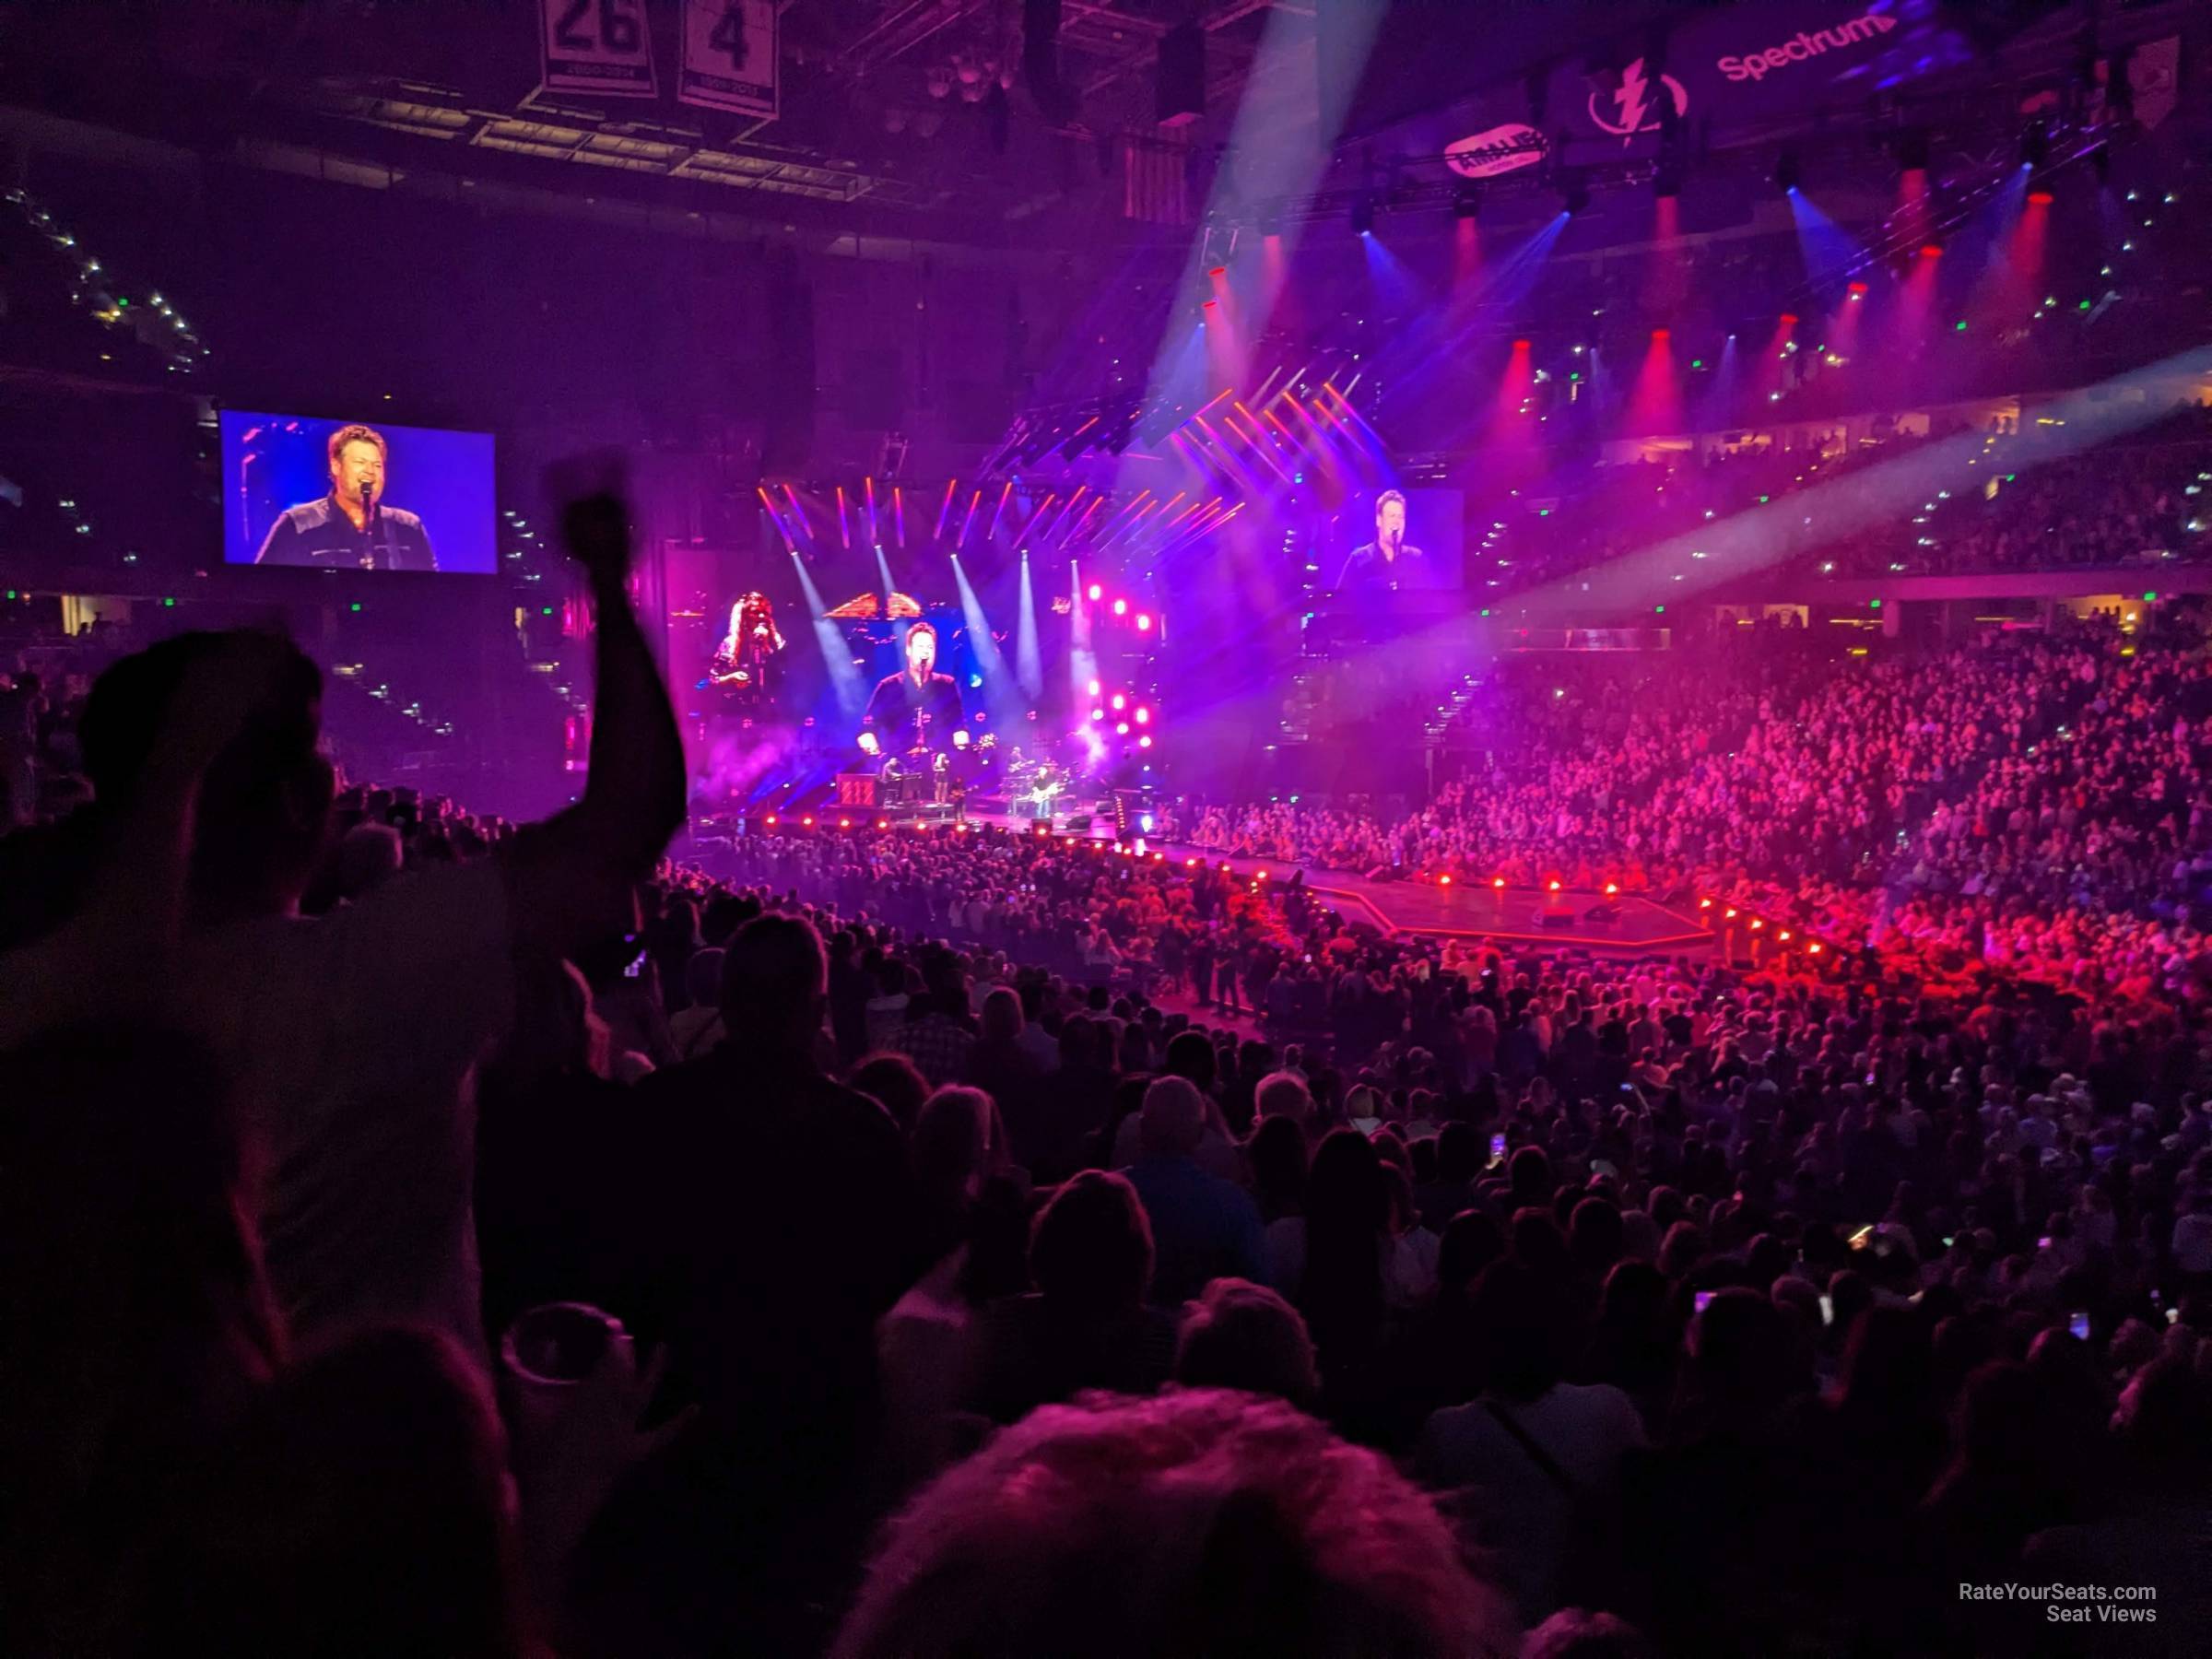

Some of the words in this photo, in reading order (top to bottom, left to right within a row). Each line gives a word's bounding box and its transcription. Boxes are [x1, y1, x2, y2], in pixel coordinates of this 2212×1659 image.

[554, 0, 640, 53] 26
[708, 0, 750, 71] 4
[1717, 15, 1896, 81] Spectrum
